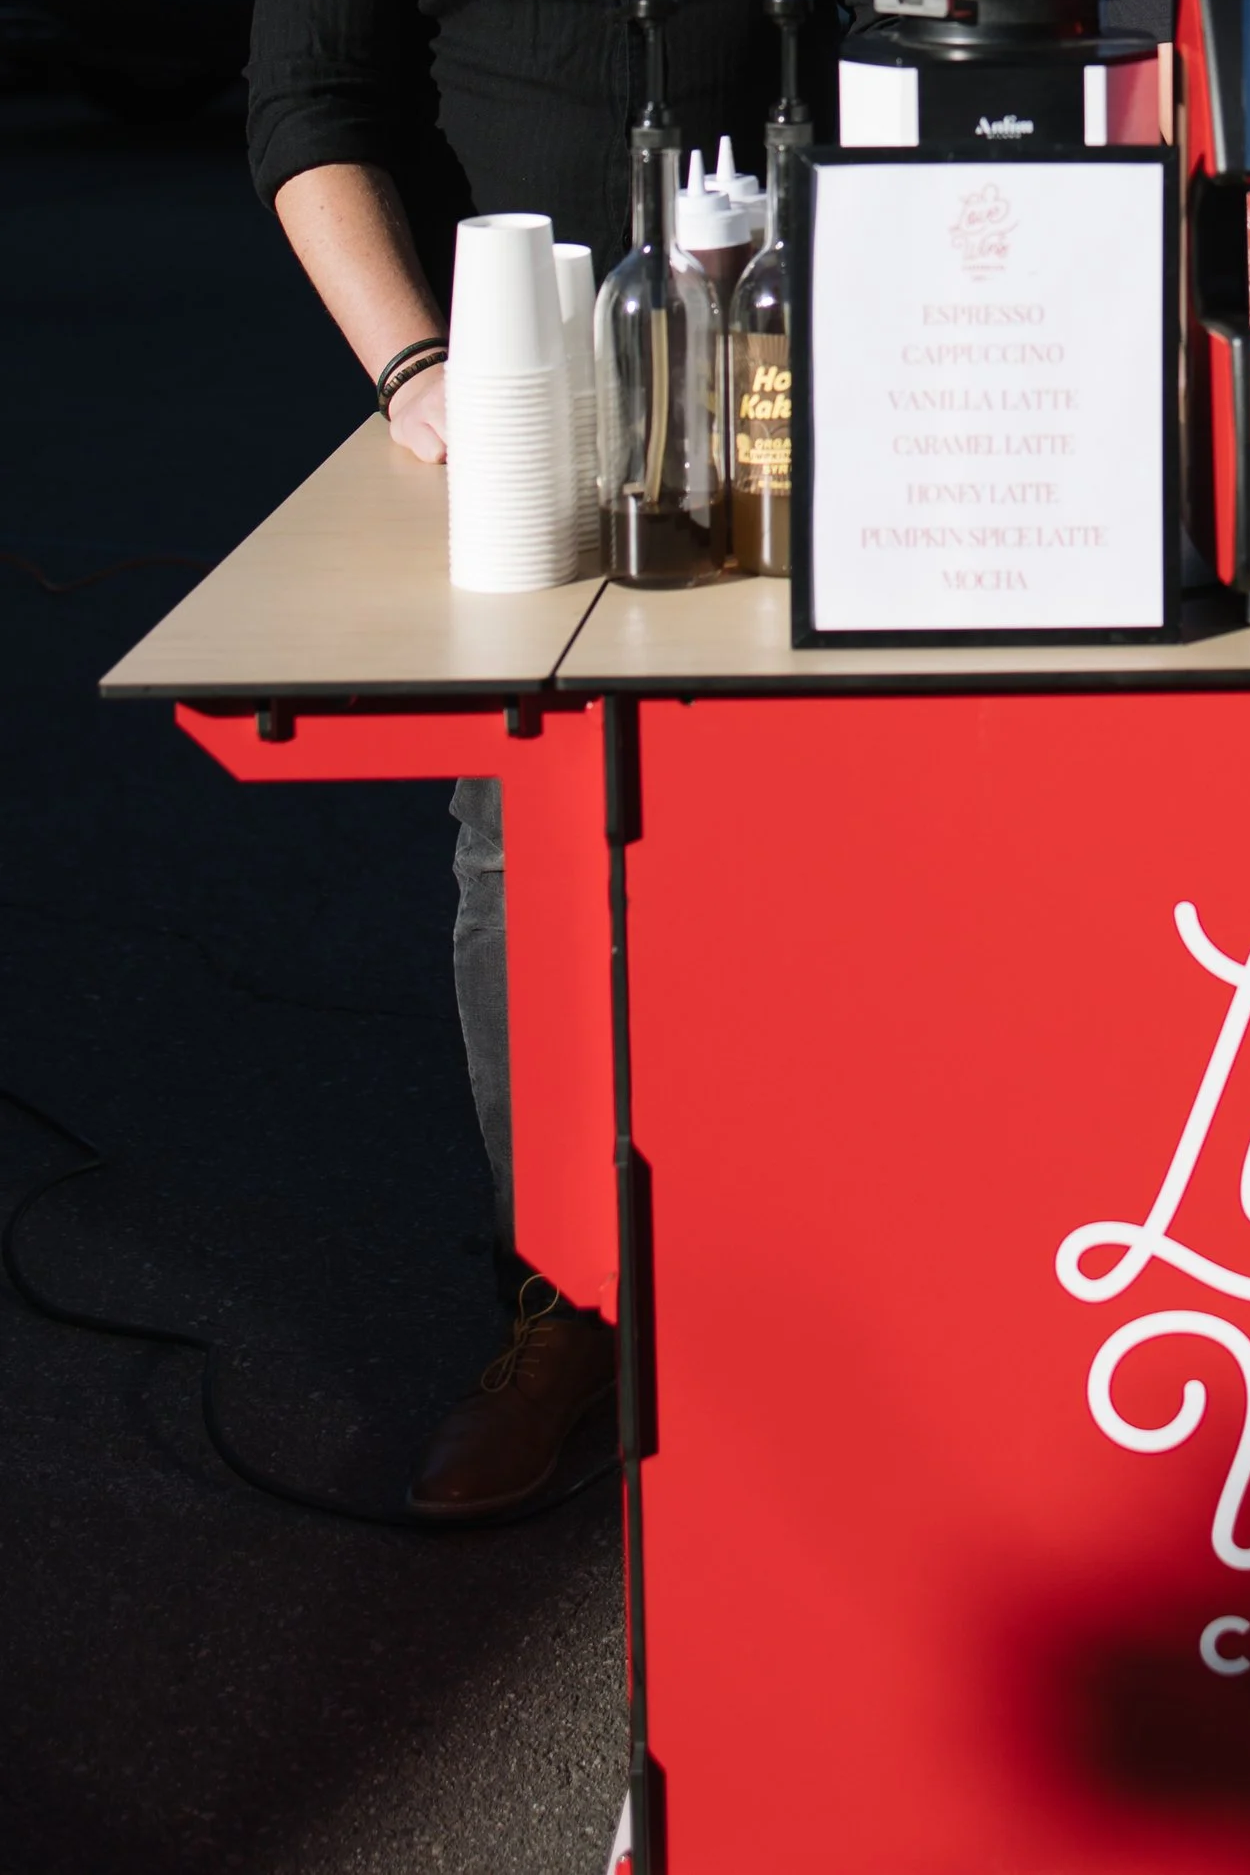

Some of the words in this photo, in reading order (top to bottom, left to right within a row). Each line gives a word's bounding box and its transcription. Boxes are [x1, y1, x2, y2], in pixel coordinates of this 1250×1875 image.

[922, 303, 1046, 326] ESPRESSO
[901, 343, 1066, 366] CAPPUCCINO
[752, 365, 792, 392] Ho
[740, 393, 792, 420] Kak
[887, 389, 994, 412] VANILLA
[1001, 389, 1079, 411] LATTE
[755, 438, 792, 449] ORGA
[892, 433, 1001, 457] CARAMEL
[1004, 433, 1075, 456] LATTE
[906, 482, 984, 506] HONEY
[989, 482, 1060, 505] LATTE
[860, 526, 964, 550] PUMPKIN
[968, 525, 1032, 549] SPICE
[1036, 525, 1108, 548] LATTE
[941, 569, 1029, 592] MOCHA
